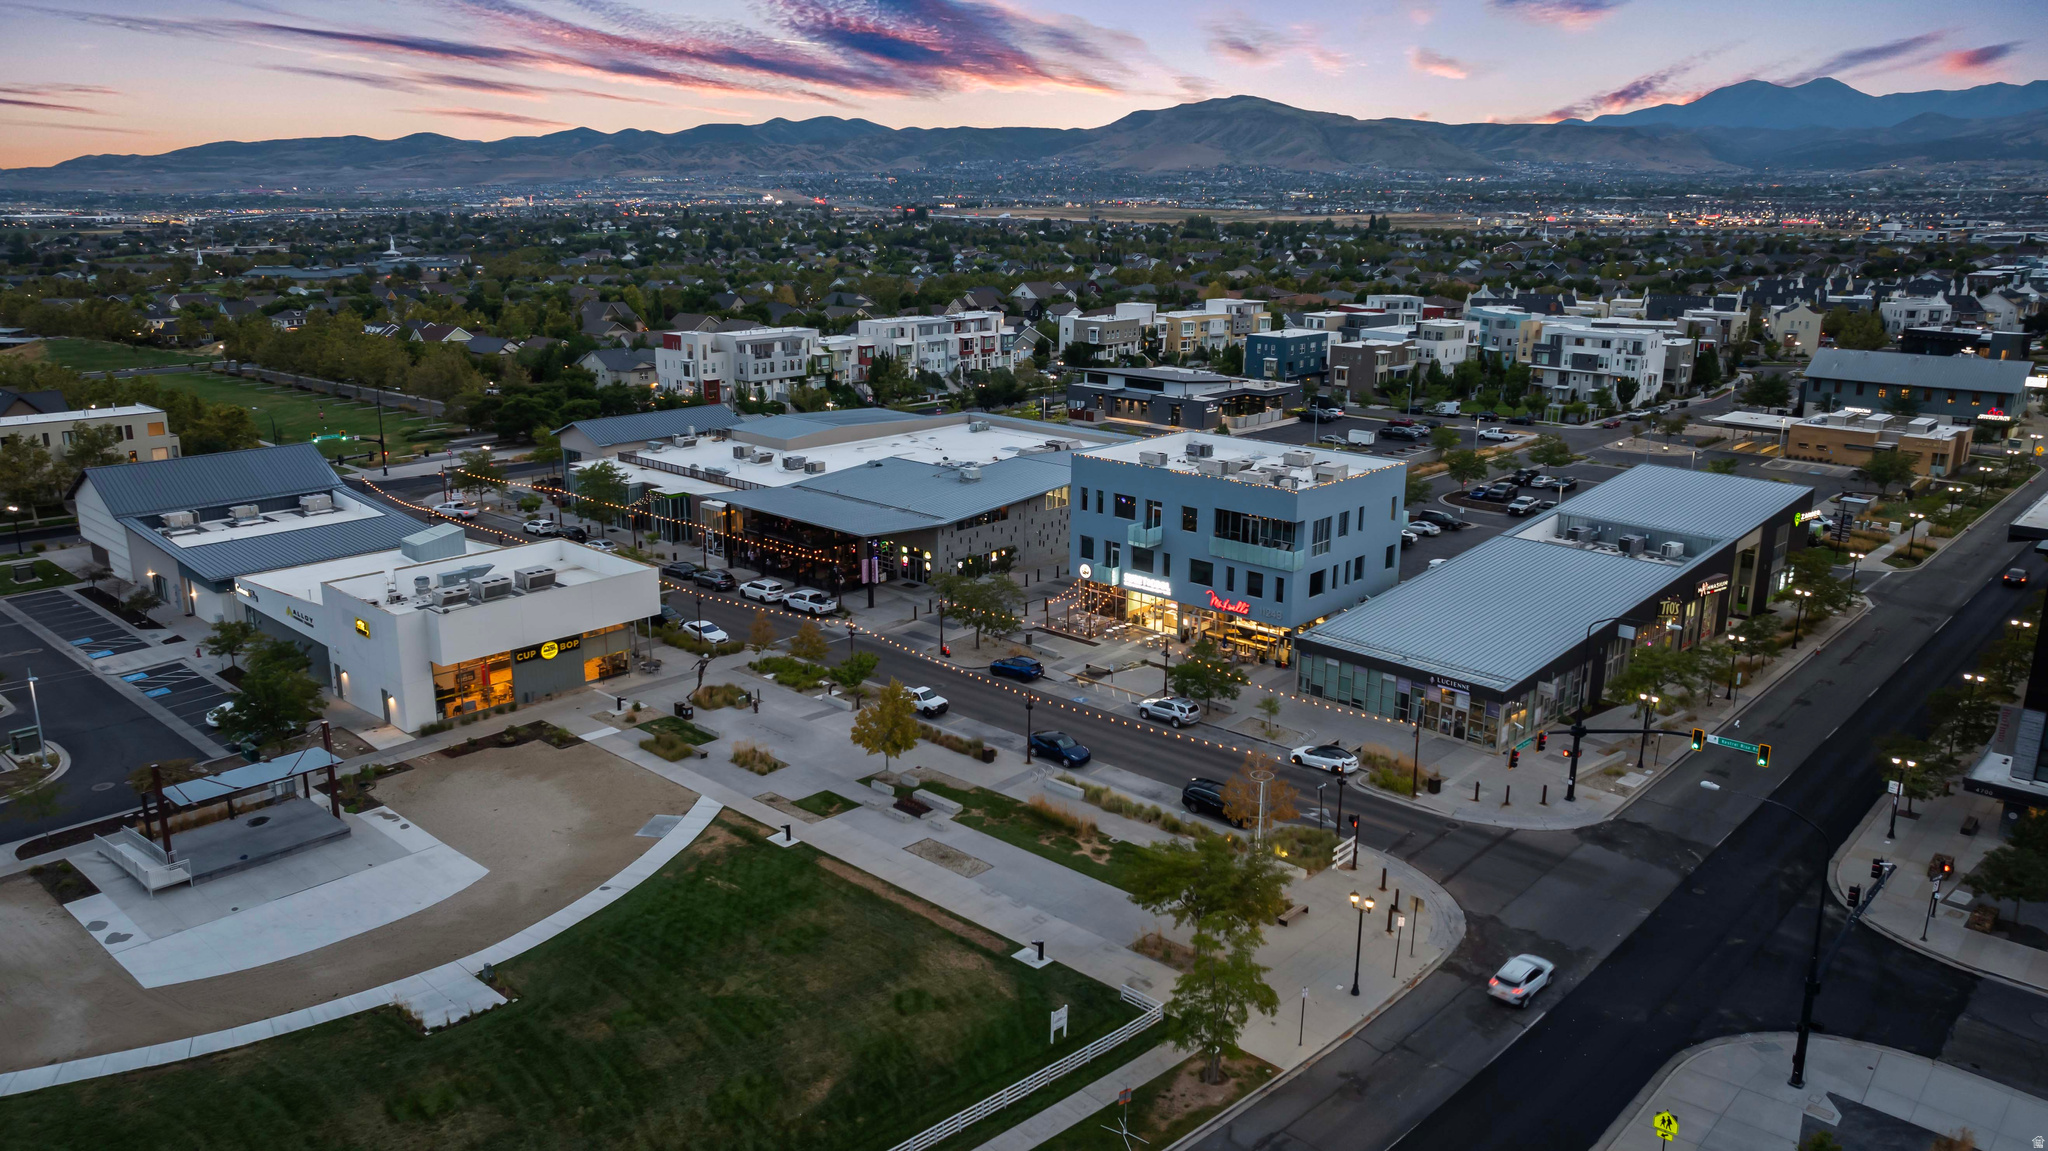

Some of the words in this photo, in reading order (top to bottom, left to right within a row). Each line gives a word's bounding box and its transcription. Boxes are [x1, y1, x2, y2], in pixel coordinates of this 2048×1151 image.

[292, 609, 313, 623] ALLOY
[516, 650, 536, 661] CUP
[560, 639, 579, 651] BOP
[1437, 677, 1470, 691] LUCIENNE
[1975, 787, 1993, 796] 4700
